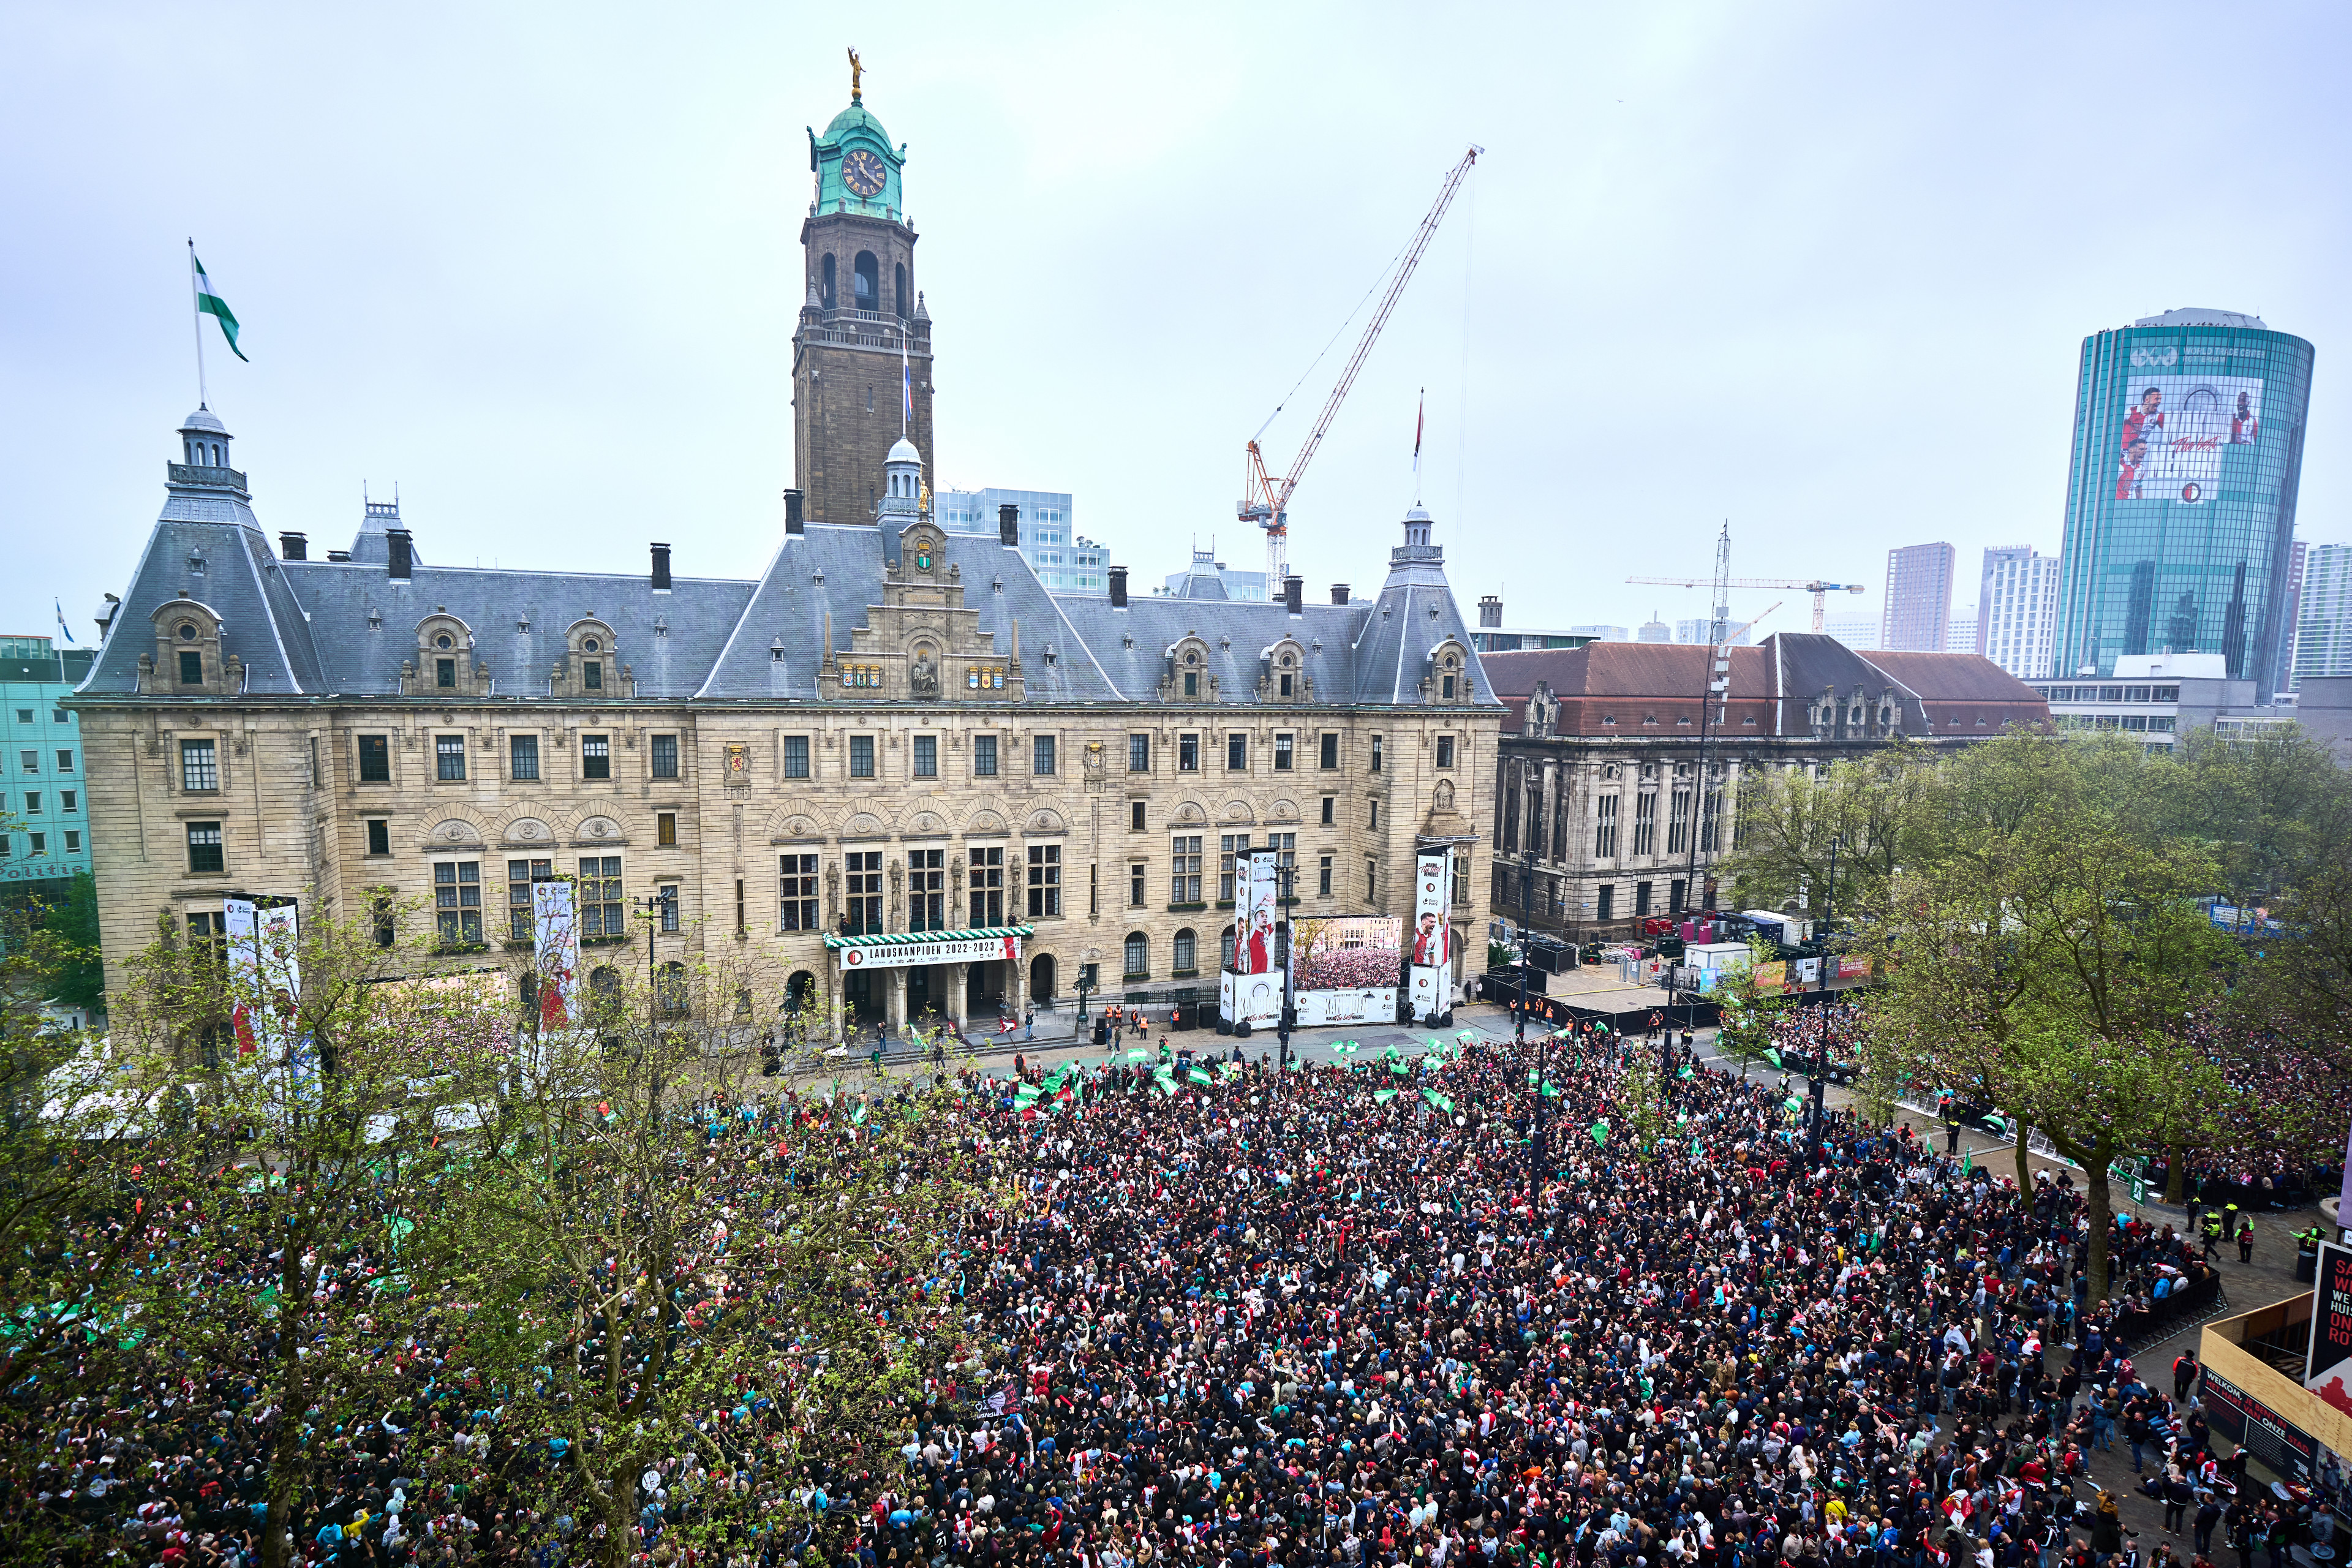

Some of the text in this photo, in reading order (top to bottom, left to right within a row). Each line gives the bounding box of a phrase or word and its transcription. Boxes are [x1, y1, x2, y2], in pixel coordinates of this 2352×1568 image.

[2215, 348, 2239, 356] TRADE
[2240, 349, 2266, 358] CENTER
[2172, 436, 2196, 454] The
[870, 941, 994, 959] LANDSKAMPIOEN 2022-2023
[2332, 1290, 2350, 1305] WE
[2330, 1313, 2351, 1332] ON
[2207, 1370, 2242, 1401] WELKOM,
[2244, 1398, 2253, 1407] JE
[2255, 1404, 2275, 1422] BENT
[2277, 1419, 2287, 1430] IN
[2206, 1380, 2219, 1393] HET
[2221, 1389, 2242, 1408] HART
[2243, 1404, 2261, 1421] VAN
[2262, 1418, 2286, 1438] ONZE
[2288, 1434, 2310, 1456] STAD.
